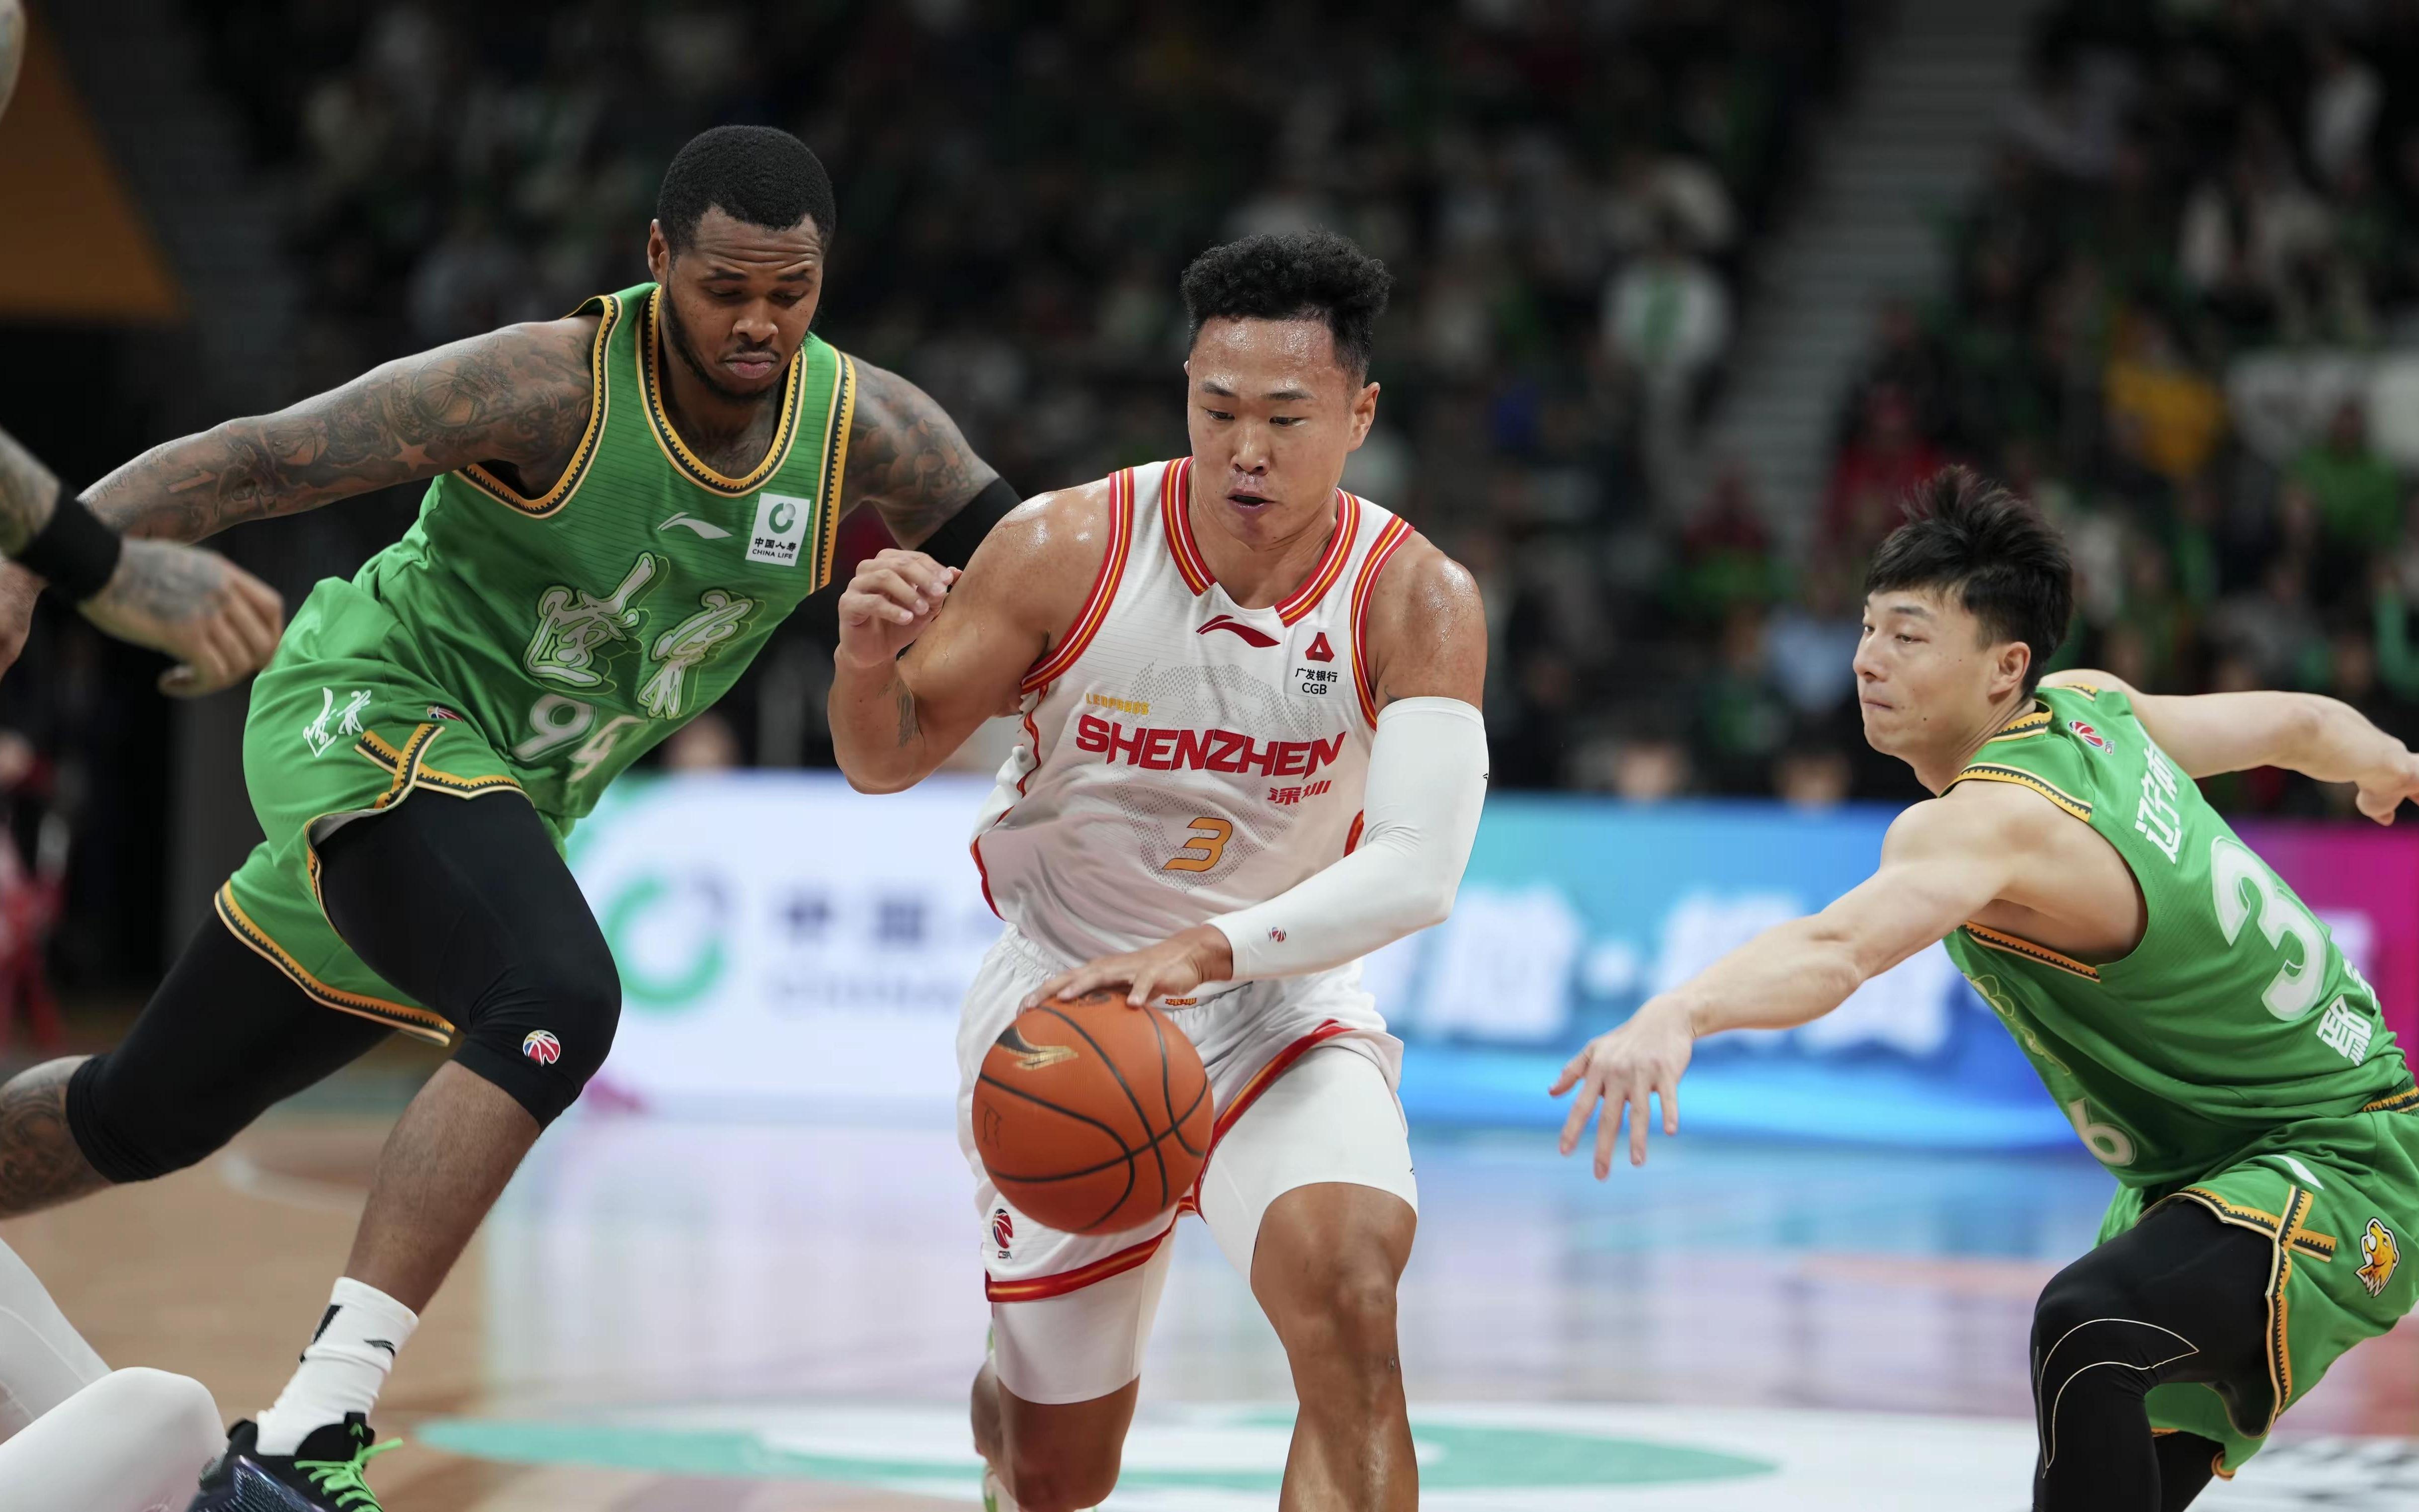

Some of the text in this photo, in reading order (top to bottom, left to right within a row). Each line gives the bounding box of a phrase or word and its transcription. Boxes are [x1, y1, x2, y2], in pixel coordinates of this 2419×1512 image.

[752, 549, 775, 557] CHINA
[754, 537, 797, 552] 中国人寿
[1295, 668, 1338, 683] 广发银行
[1302, 682, 1328, 695] CGB
[1085, 692, 1150, 716] LEOPARDS
[510, 693, 647, 784] 94
[1076, 714, 1346, 780] SHENZHEN
[1267, 780, 1332, 806] 深圳
[1162, 817, 1234, 873] 3
[2069, 1097, 2137, 1166] 6
